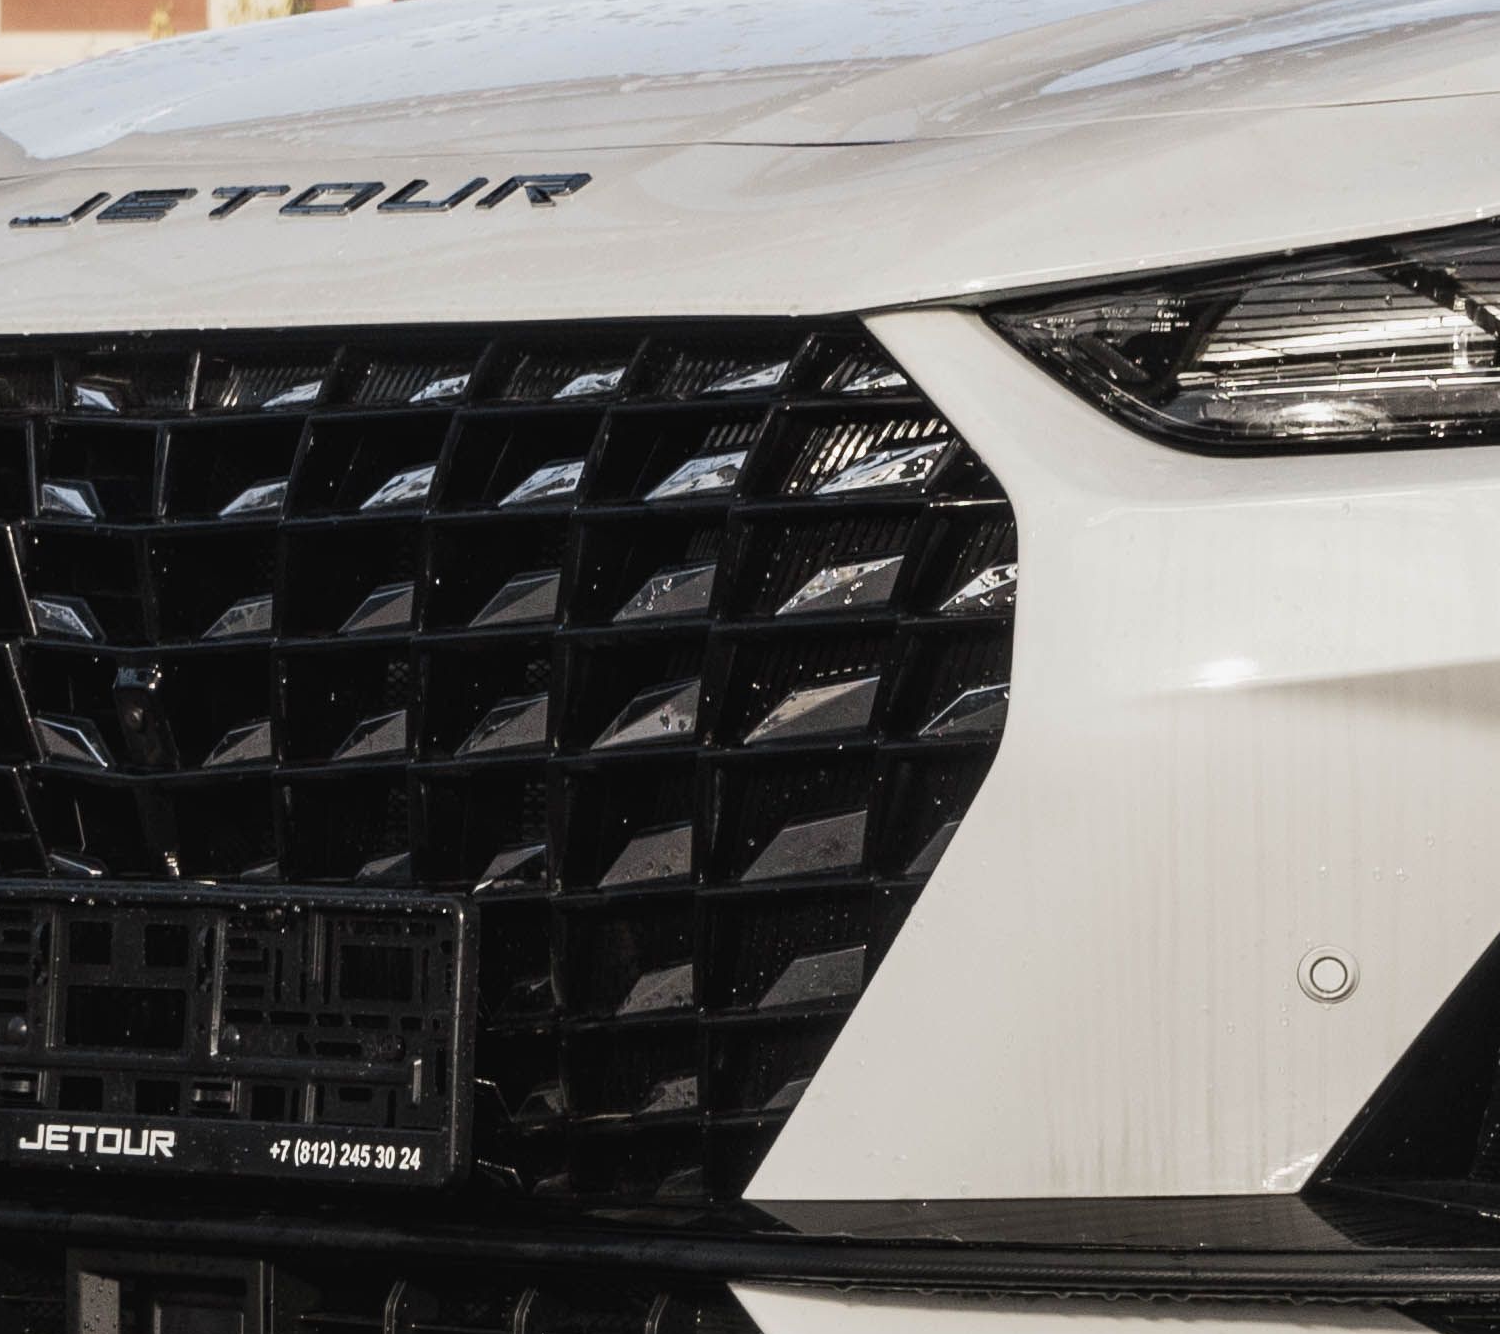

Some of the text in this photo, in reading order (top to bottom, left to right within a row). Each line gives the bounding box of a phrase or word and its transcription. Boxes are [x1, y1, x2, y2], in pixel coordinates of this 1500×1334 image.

[8, 172, 593, 229] JETOUR
[18, 1123, 178, 1158] JETOUR
[269, 1138, 422, 1171] +7 (812) 245 30 24
